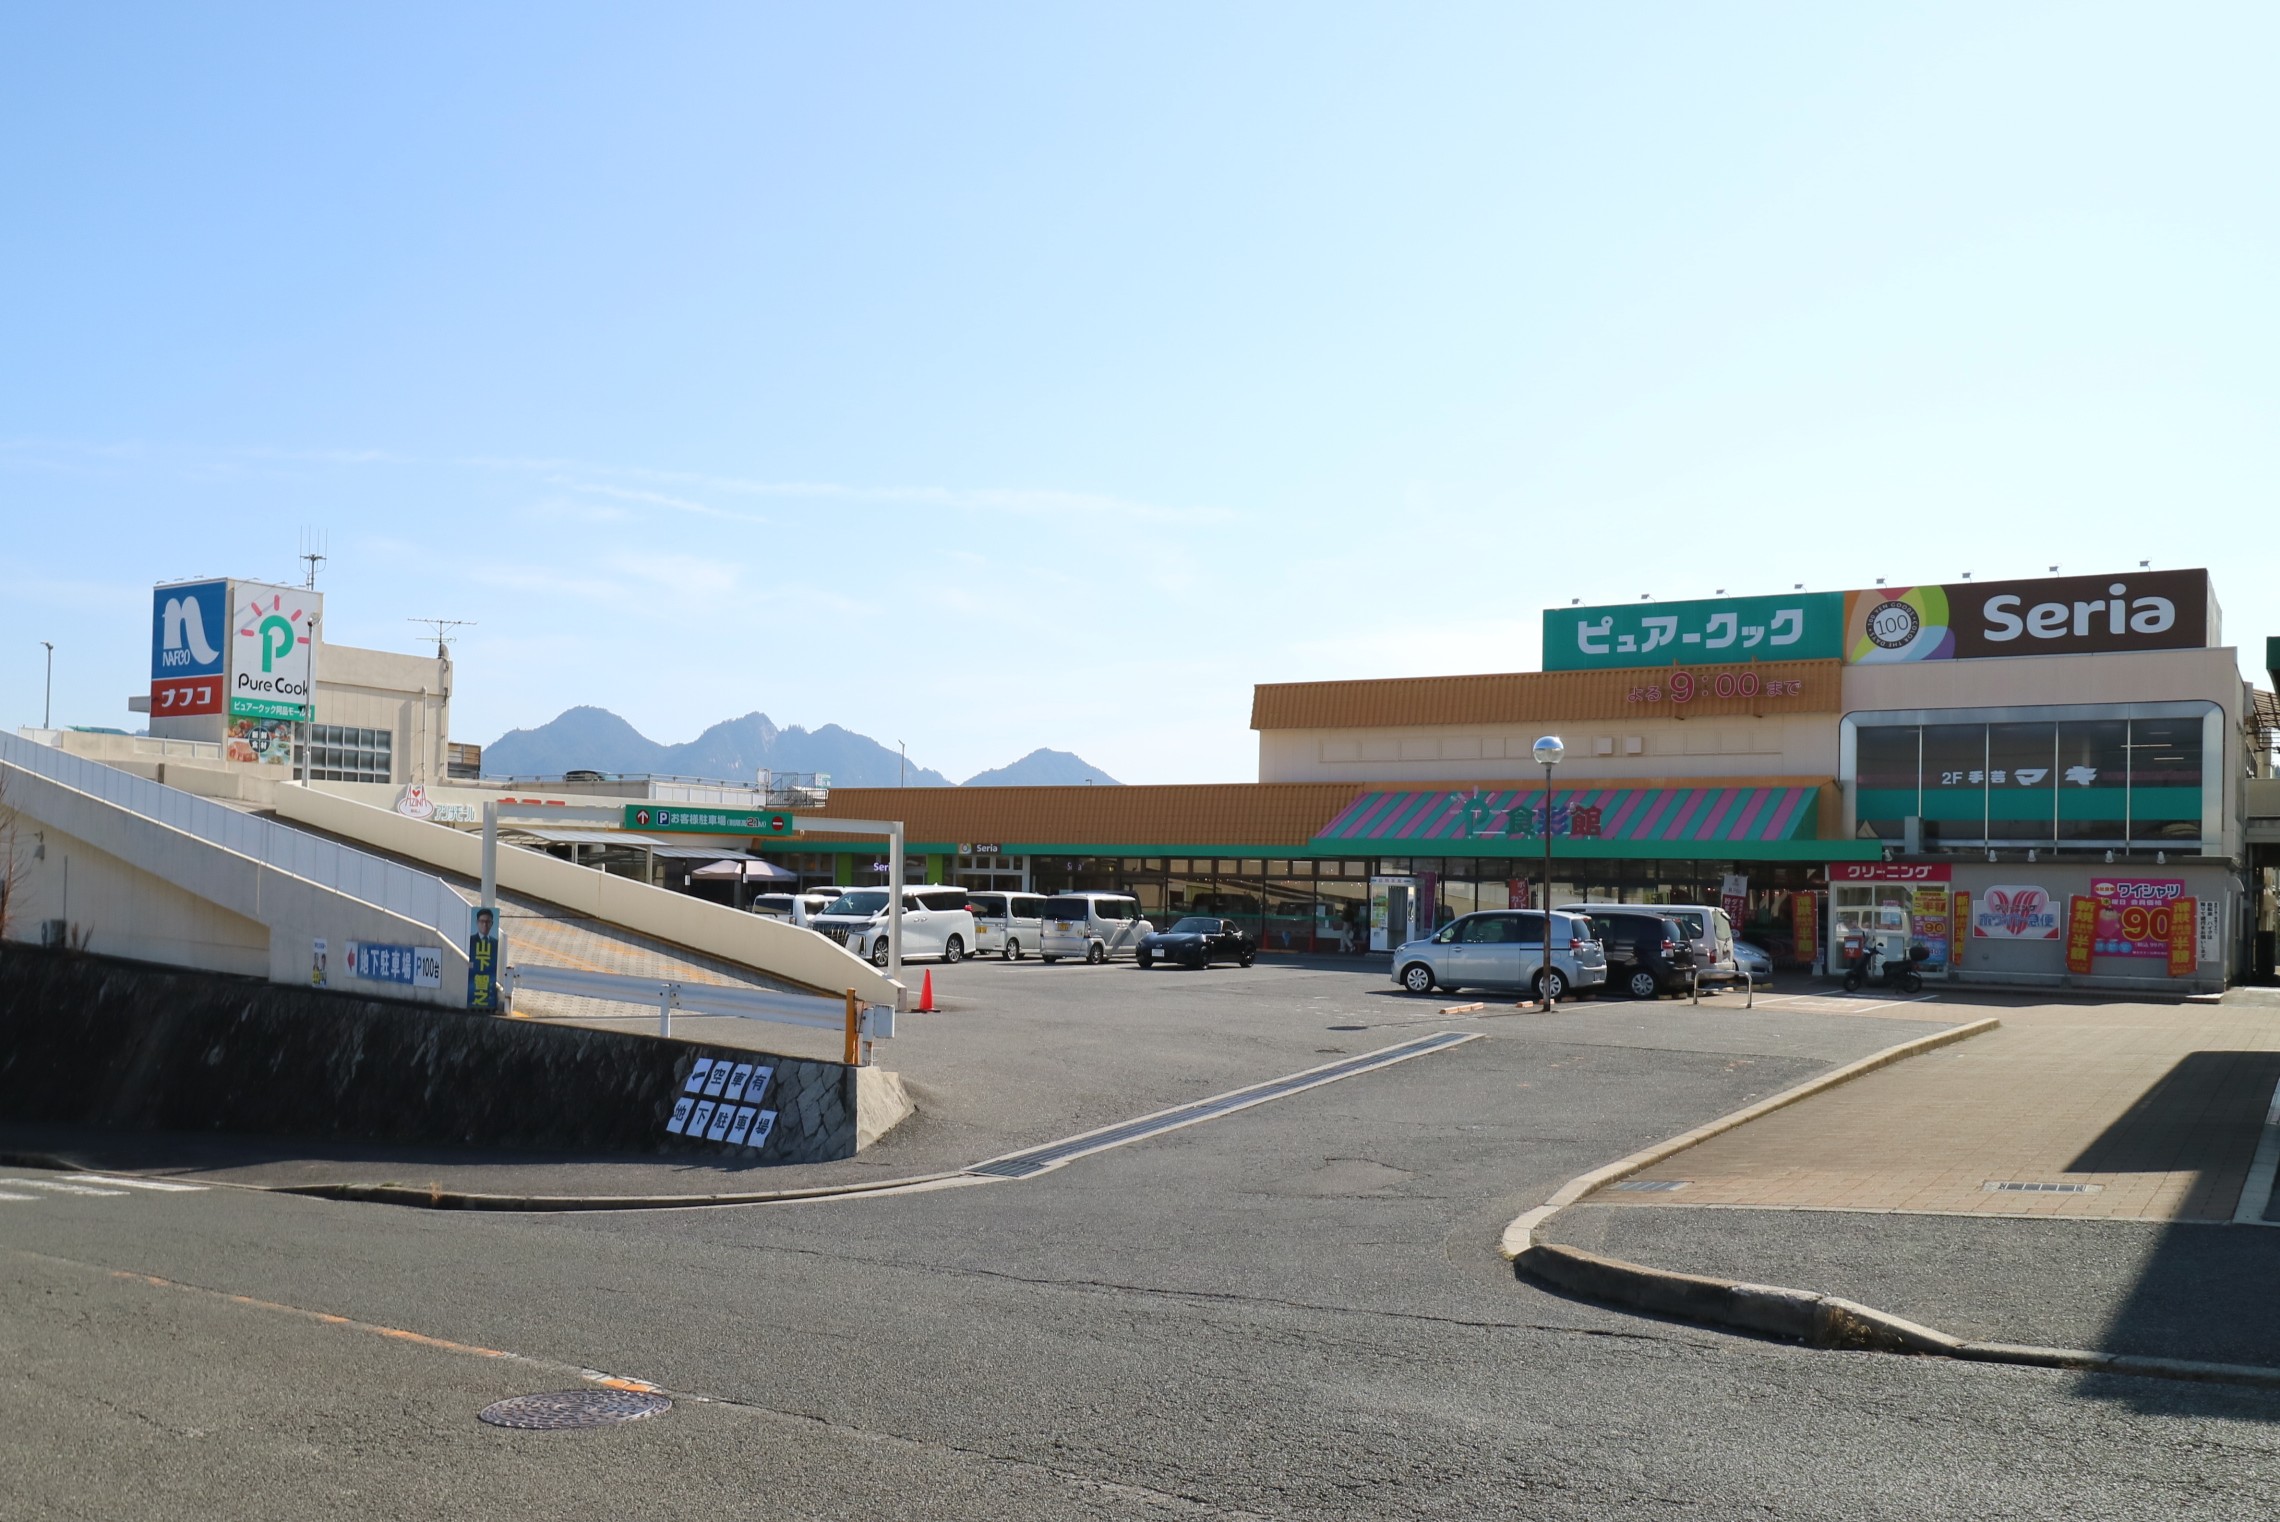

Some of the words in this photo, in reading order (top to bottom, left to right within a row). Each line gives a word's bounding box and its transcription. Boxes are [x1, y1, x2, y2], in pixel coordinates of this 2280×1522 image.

[1982, 582, 2176, 642] Seria
[1577, 608, 1804, 655] ピュアークック
[1875, 614, 1909, 636] 100
[162, 649, 191, 667] NAFCO
[238, 672, 274, 692] Pure
[274, 677, 308, 696] Cook
[1627, 686, 1662, 702] よる
[1669, 671, 1760, 703] 9:00
[1766, 680, 1802, 697] まで
[161, 686, 212, 708] ナフコ
[1941, 771, 1963, 785] 2F
[1967, 769, 2007, 784] 手芸
[670, 812, 727, 827] お客様駐車場
[1505, 804, 1603, 836] 食彩館
[976, 843, 998, 853] Seria
[1847, 865, 1933, 878] クリーニング
[1517, 881, 1527, 908] ポイント
[2117, 882, 2180, 899] ワイシャツ
[360, 949, 412, 980] 地下駐車場
[711, 1068, 767, 1092] 空車有
[673, 1104, 771, 1135] 地下駐車場
